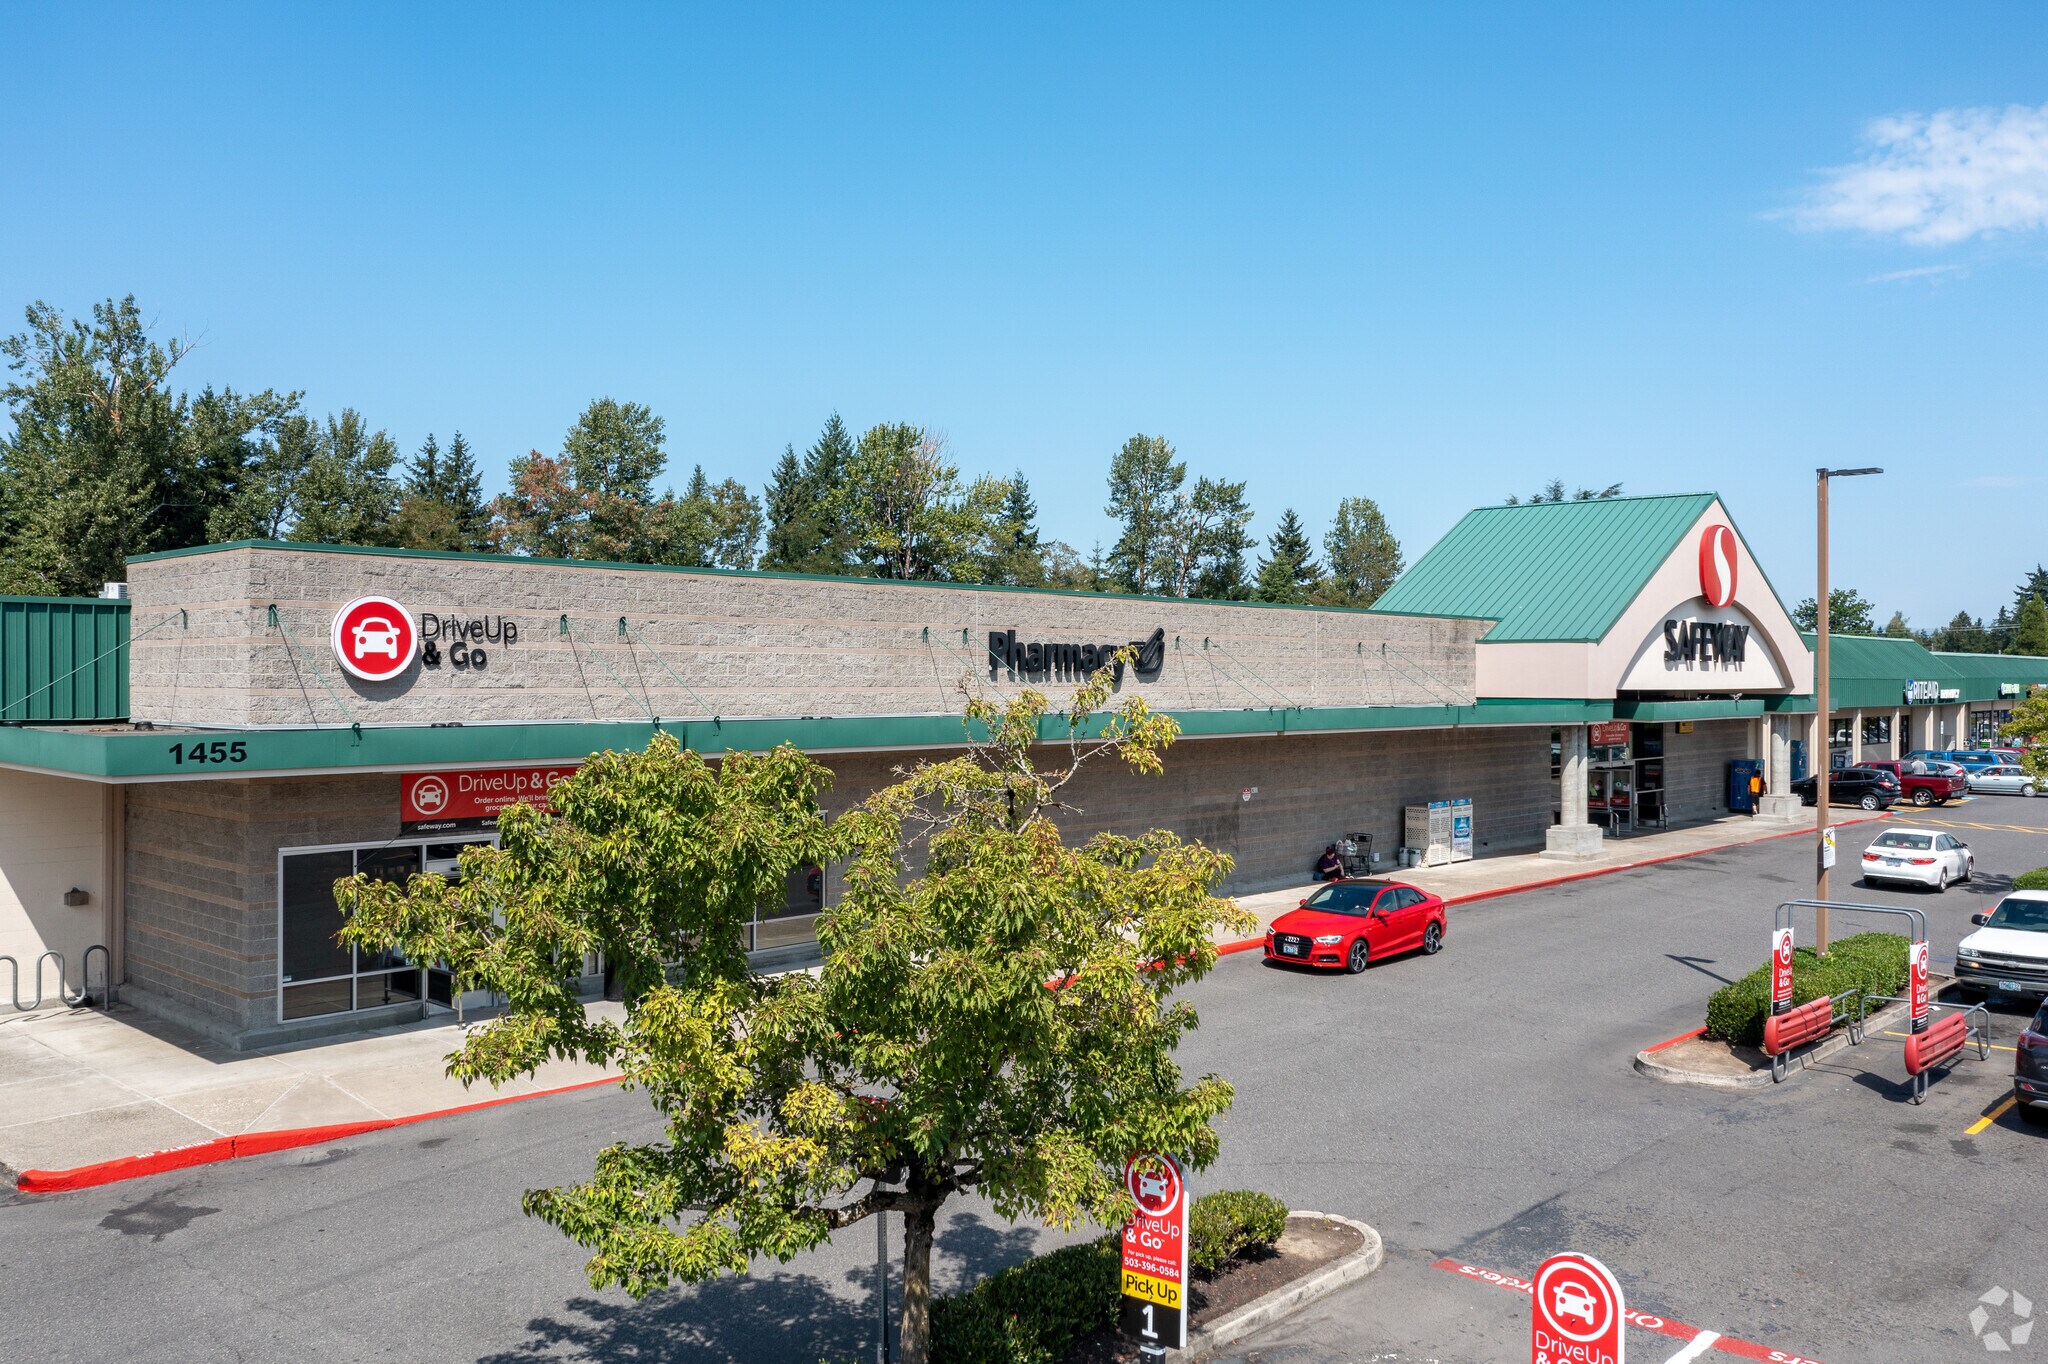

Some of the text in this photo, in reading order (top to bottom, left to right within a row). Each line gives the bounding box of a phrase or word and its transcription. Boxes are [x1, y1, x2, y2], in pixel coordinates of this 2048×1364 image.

[422, 612, 517, 646] DriveUp
[1663, 619, 1750, 662] SAFEWAY
[422, 640, 486, 667] & Go
[989, 629, 1126, 683] Pharmacy
[169, 741, 248, 764] 1455
[459, 773, 527, 793] DriveUp
[530, 772, 543, 788] &
[417, 822, 456, 830] safeway.com
[160, 1139, 214, 1153] PARKING
[1125, 1228, 1137, 1244] &
[1124, 1256, 1180, 1279] 503-396-0584
[1152, 1256, 1167, 1264] please
[1126, 1274, 1178, 1304] Pick Up
[1141, 1304, 1159, 1339] 1
